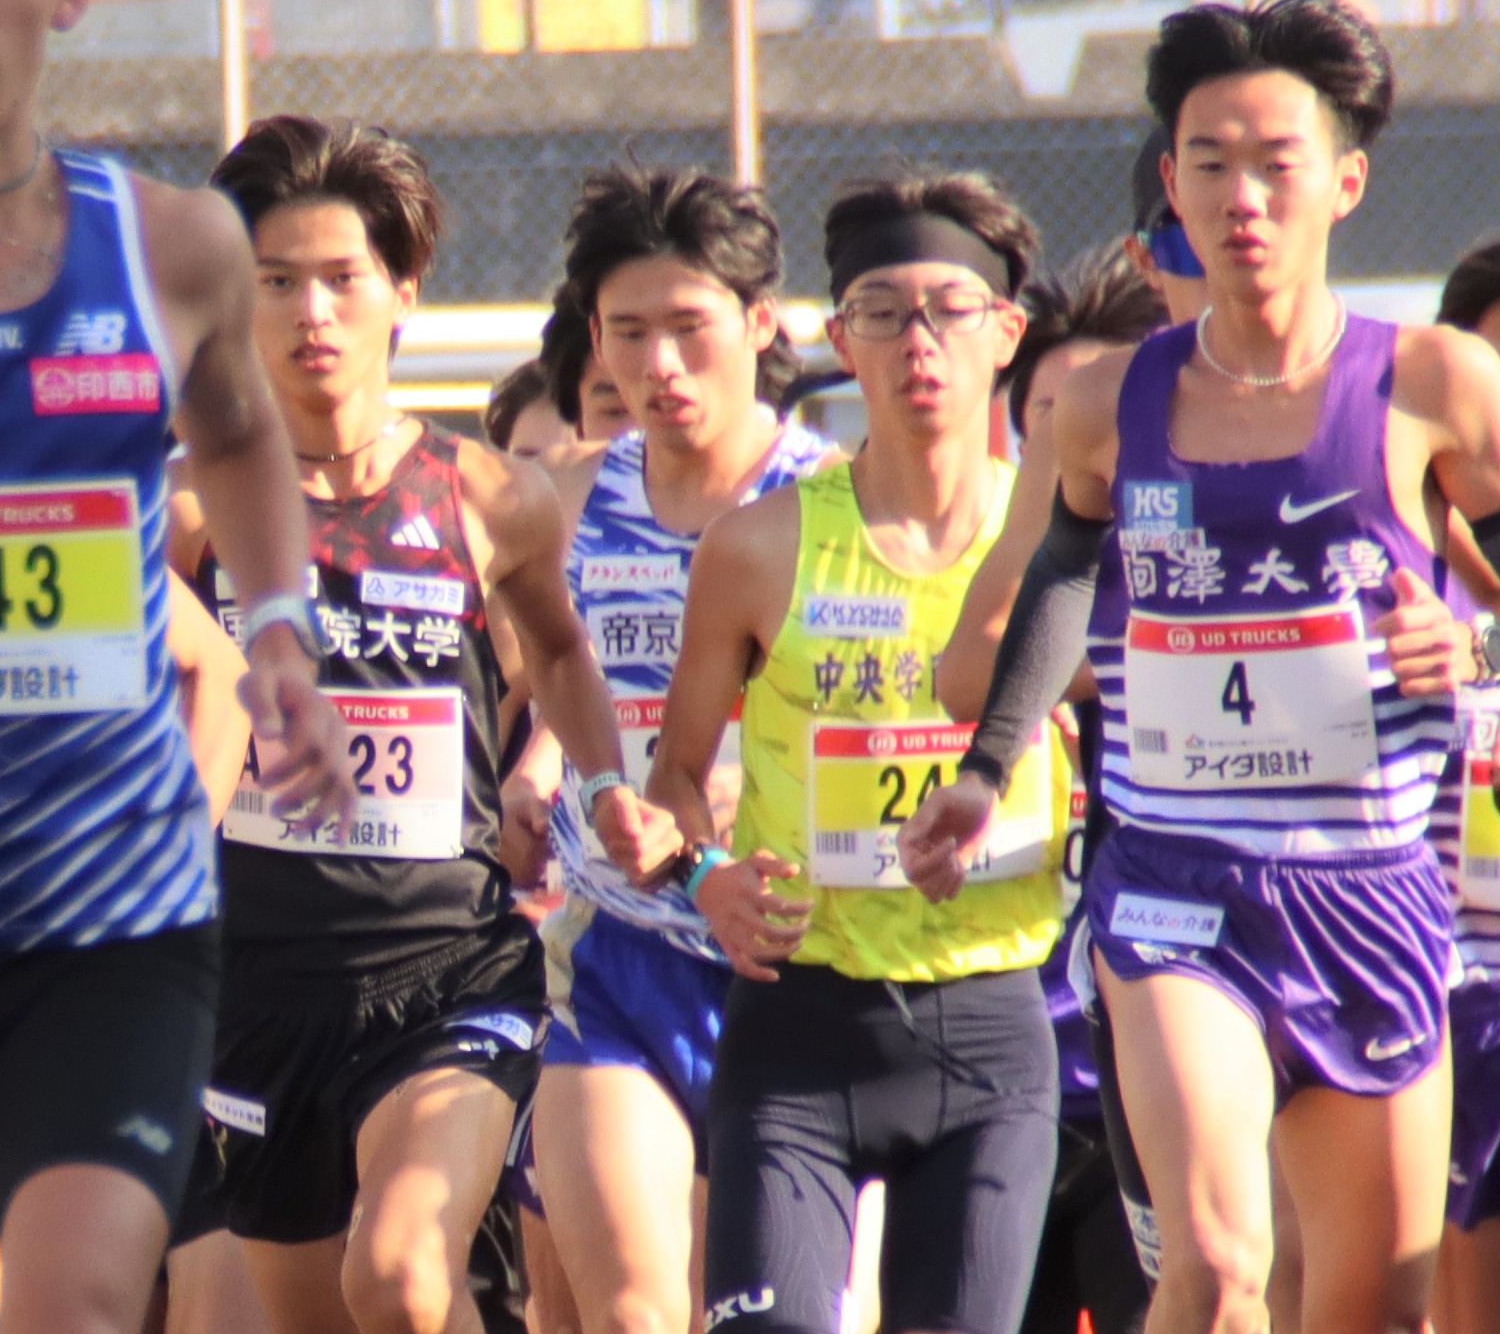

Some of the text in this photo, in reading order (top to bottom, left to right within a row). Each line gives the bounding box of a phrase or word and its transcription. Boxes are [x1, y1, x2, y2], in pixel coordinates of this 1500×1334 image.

[1134, 486, 1178, 517] HRS
[392, 580, 460, 604] アサカミ
[602, 611, 679, 656] 帝京
[1201, 633, 1226, 646] UD
[1231, 628, 1301, 644] TRUCKS
[815, 651, 942, 703] 中央学
[1221, 661, 1256, 726] 4
[344, 705, 409, 721] TRUCKS
[902, 735, 927, 749] UD
[1185, 748, 1313, 779] アイダ設計
